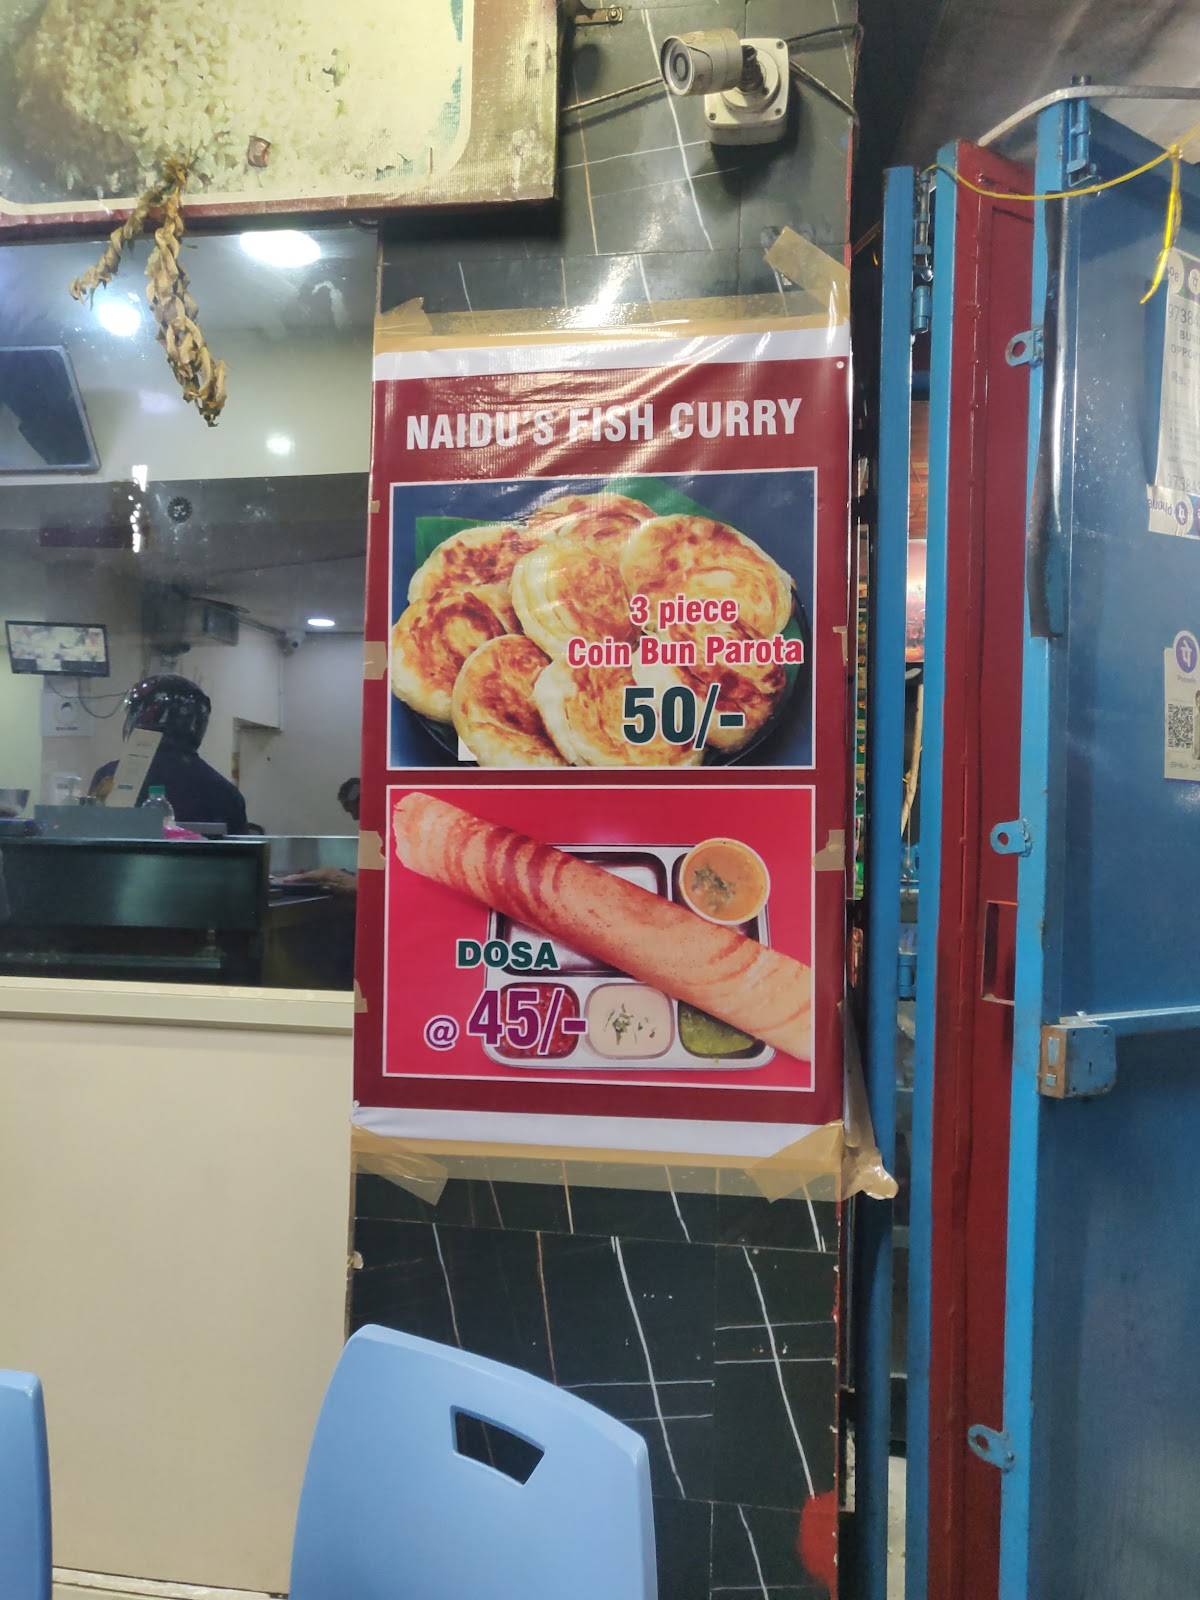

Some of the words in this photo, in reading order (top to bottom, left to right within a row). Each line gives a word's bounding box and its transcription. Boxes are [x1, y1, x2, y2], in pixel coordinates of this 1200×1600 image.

[407, 410, 554, 449] NAIDU'S
[569, 403, 654, 442] FISH
[670, 398, 802, 439] CURRY
[631, 594, 649, 625] 3
[659, 594, 738, 630] piece
[568, 637, 631, 667] Coin
[640, 636, 696, 666] Bun
[706, 635, 803, 665] Parota
[623, 683, 745, 749] 50/-
[457, 939, 559, 970] DOSA
[425, 1016, 459, 1050] @
[467, 988, 587, 1055] 45/-
